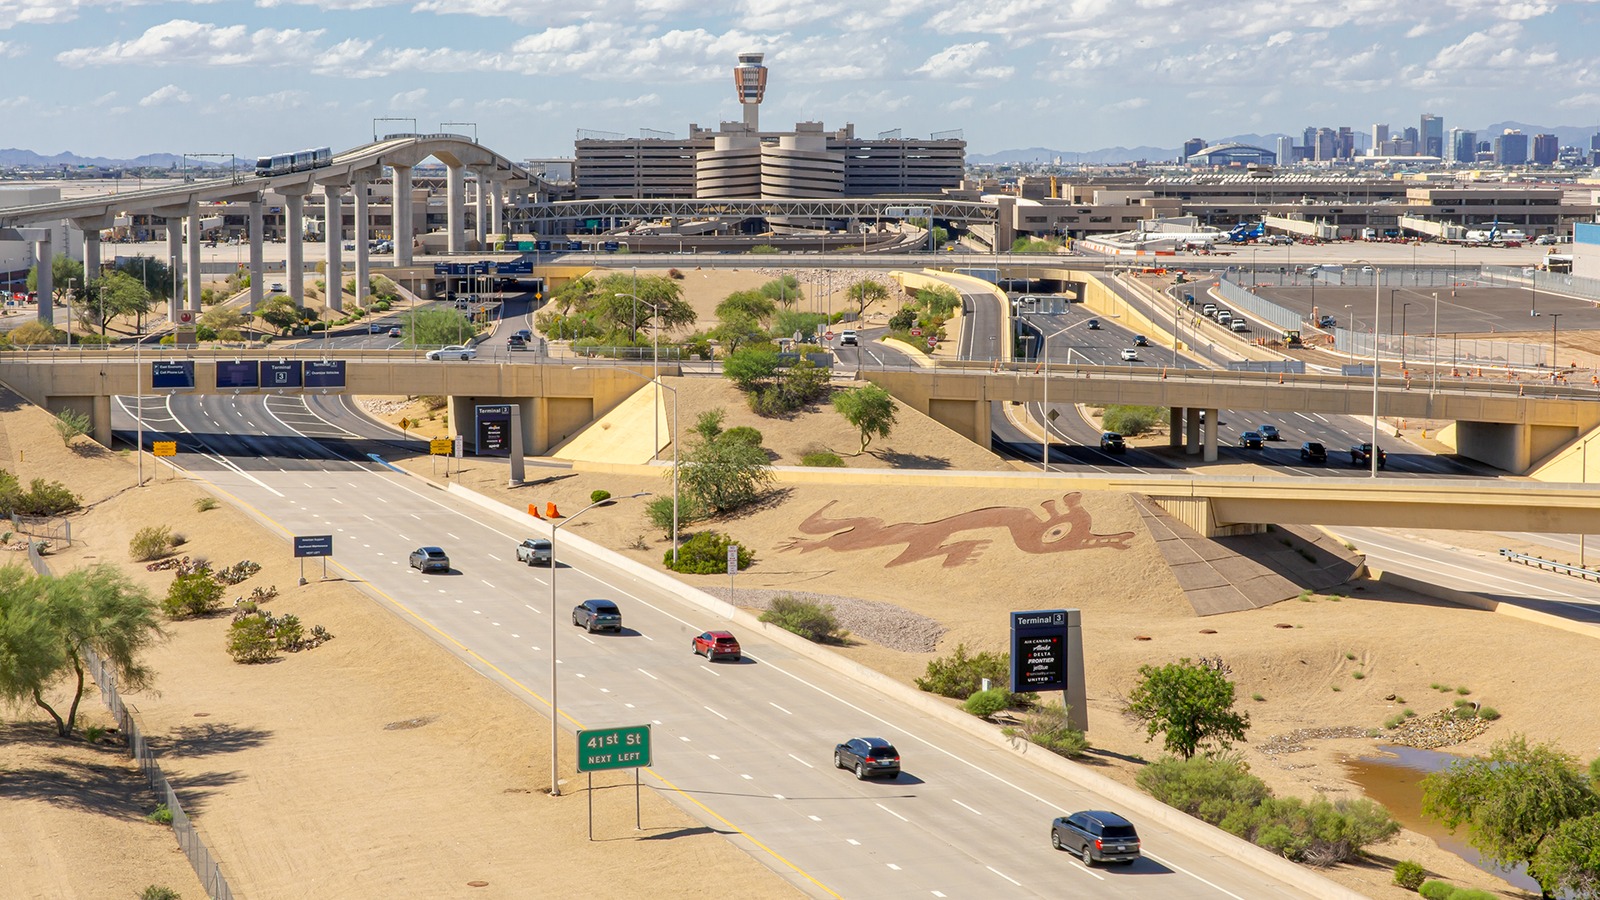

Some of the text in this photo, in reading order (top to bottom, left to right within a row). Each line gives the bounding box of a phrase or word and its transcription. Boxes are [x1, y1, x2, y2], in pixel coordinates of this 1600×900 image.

[1018, 616, 1051, 624] Terminal
[587, 733, 641, 748] 41st St
[588, 752, 640, 764] NEXT LEFT
